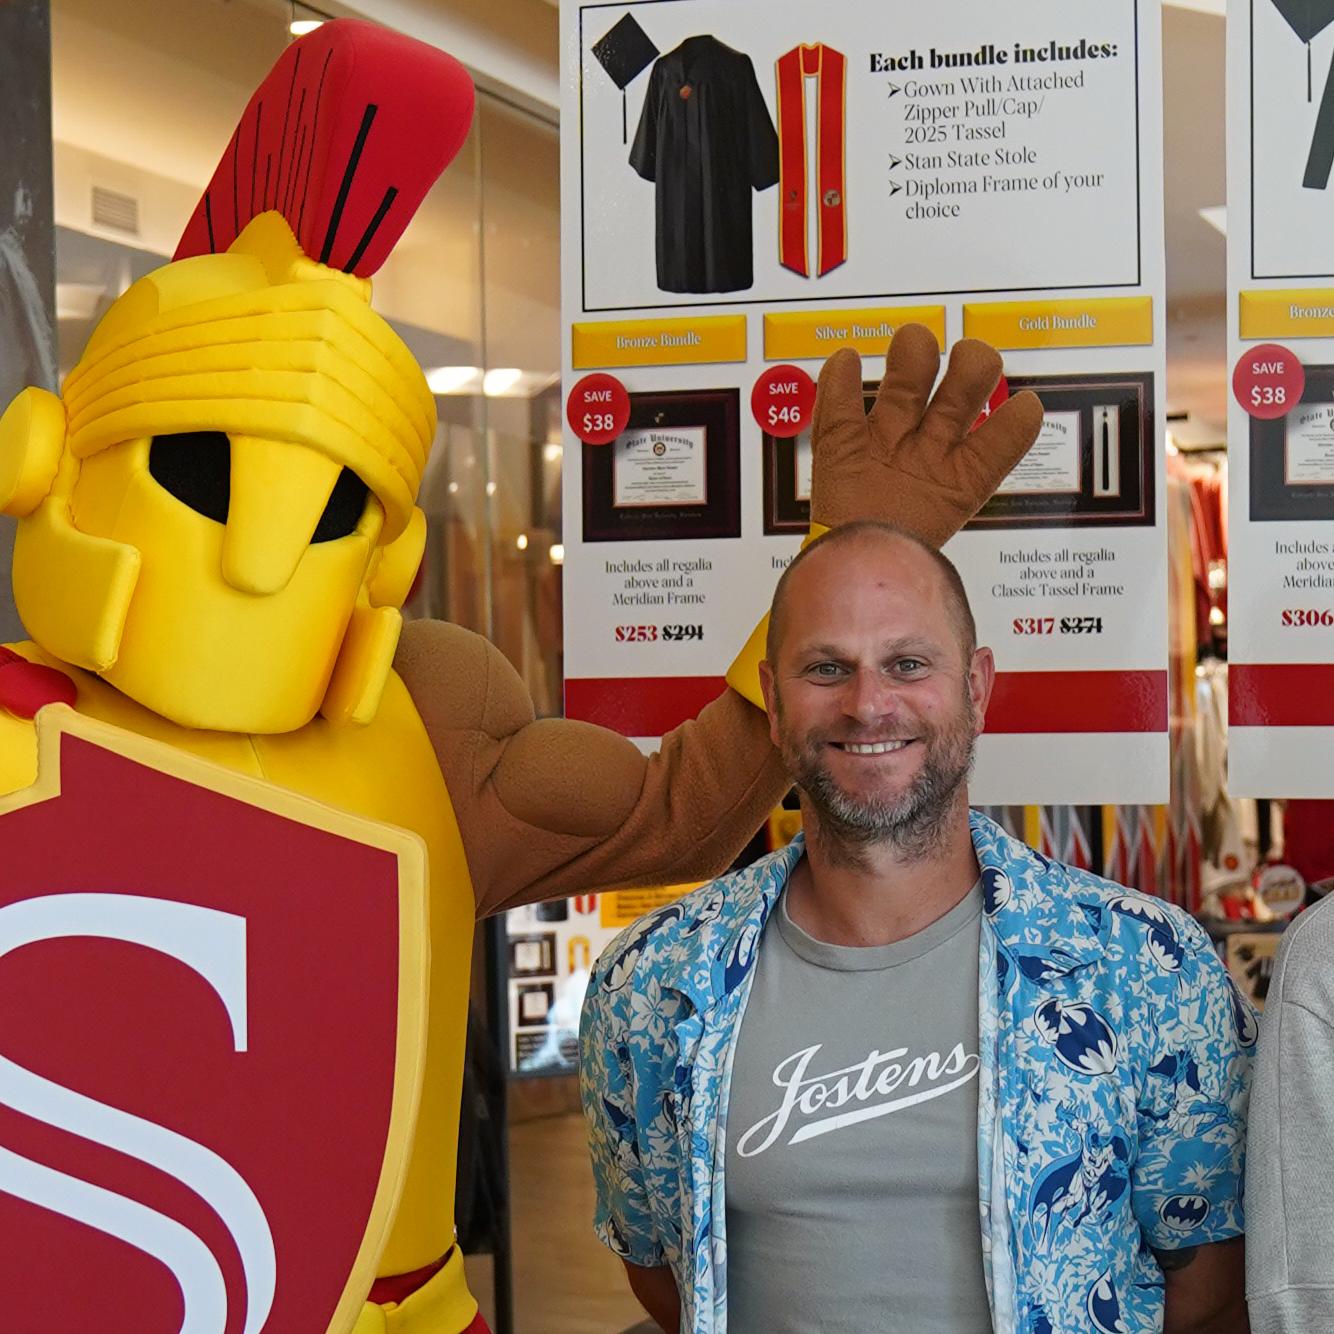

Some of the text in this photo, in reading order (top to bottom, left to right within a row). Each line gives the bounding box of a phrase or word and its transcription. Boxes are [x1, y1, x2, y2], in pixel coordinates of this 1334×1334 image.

[869, 39, 1118, 72] Each bundle includes:
[904, 71, 1084, 99] Gown With Attached
[904, 95, 1045, 124] Zipper Pull/Cap/
[905, 121, 1006, 144] 2025 Tassel
[905, 147, 1036, 170] Stan State Stole
[906, 171, 1104, 199] Diploma Frame of your
[906, 202, 960, 219] choice
[1289, 305, 1334, 319] Bronze
[1019, 314, 1096, 330] Gold Bundle
[617, 332, 700, 349] Bronze Bundle
[815, 324, 894, 339] Silver Bundle
[1252, 363, 1284, 374] SAVE
[584, 391, 612, 402] SAVE
[769, 383, 798, 394] SAVE
[1251, 387, 1286, 405] $38
[583, 414, 613, 432] $38
[768, 405, 800, 425] $46
[606, 558, 712, 574] Includes all regalia
[612, 591, 705, 605] Meridian Frame
[1013, 618, 1054, 635] $317
[1282, 609, 1334, 627] $306
[615, 624, 703, 642] $253 $291
[737, 1042, 981, 1158] Jostens
